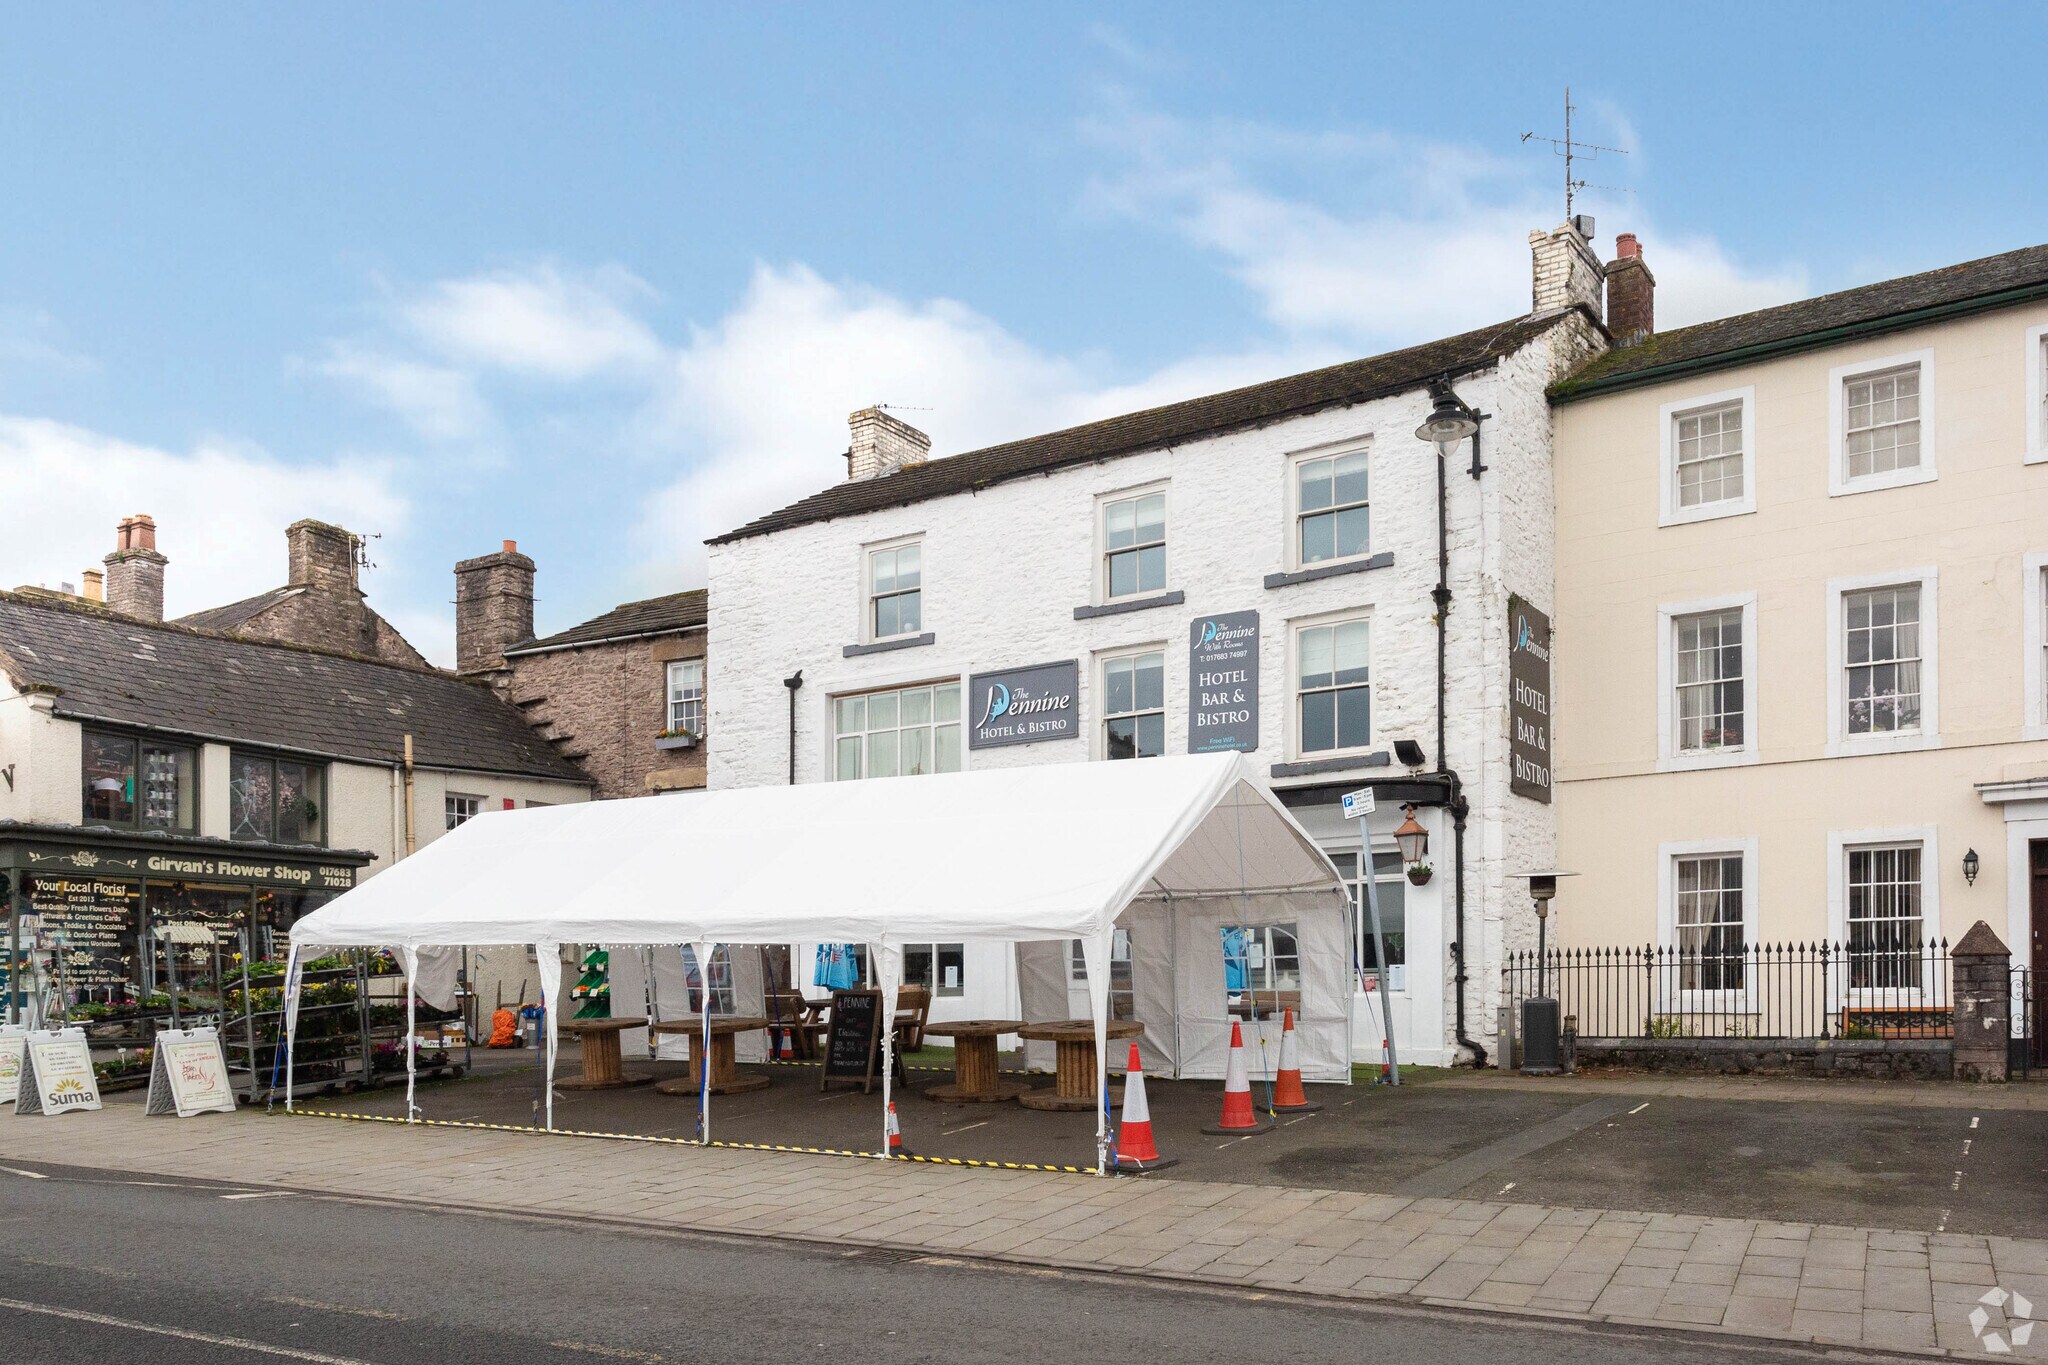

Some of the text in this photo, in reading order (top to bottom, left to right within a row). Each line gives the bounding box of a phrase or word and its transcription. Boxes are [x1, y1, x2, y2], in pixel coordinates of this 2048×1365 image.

[1205, 640, 1243, 651] With Rooms
[1513, 615, 1549, 662] Pennine
[1206, 653, 1228, 662] 017683
[1199, 670, 1248, 687] HOTEL
[1012, 688, 1029, 700] The
[1202, 688, 1246, 706] BAR &
[1515, 677, 1548, 715] HOTEL
[976, 683, 1070, 729] Pennine
[1197, 710, 1250, 726] BISTRO
[980, 719, 1067, 739] HOTEL & BISTRO
[1517, 716, 1546, 751] BAR &
[1515, 753, 1549, 788] BISTRO
[147, 856, 311, 883] Girvan's Flower Shop
[319, 867, 351, 877] 017683
[35, 880, 126, 894] Your Local Florist
[324, 877, 352, 887] 71028
[67, 912, 73, 920] &
[74, 913, 103, 921] Greetings
[104, 914, 122, 922] Cards
[87, 922, 94, 930] &
[843, 996, 870, 1009] PENNINE
[48, 1091, 94, 1106] Suma
